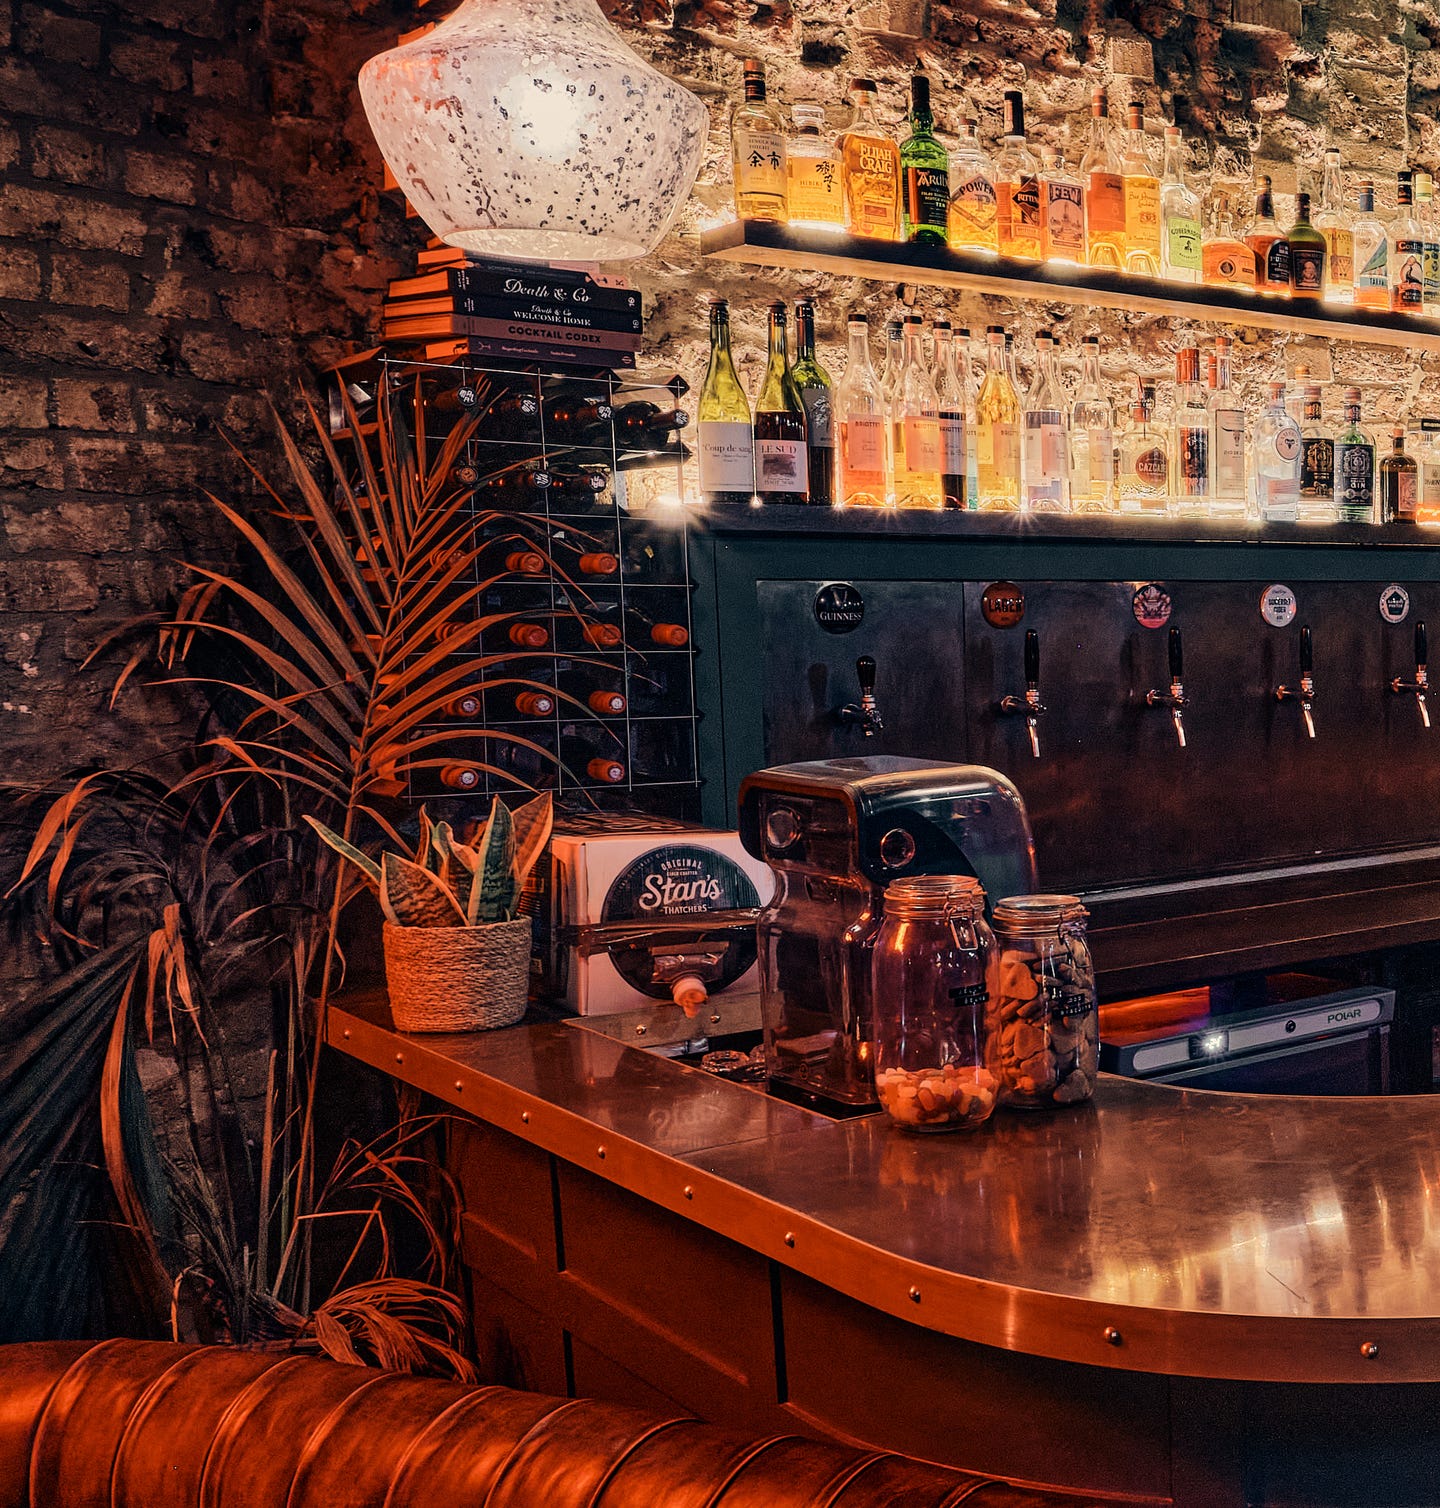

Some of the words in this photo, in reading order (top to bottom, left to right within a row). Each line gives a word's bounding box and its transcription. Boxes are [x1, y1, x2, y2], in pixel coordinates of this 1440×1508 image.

[860, 143, 892, 161] ELIJAH
[860, 156, 892, 174] CRAIG
[1052, 184, 1080, 203] FEW
[503, 278, 550, 298] Death
[553, 288, 568, 302] &
[572, 287, 592, 303] Co
[513, 310, 562, 324] WELCOME
[563, 316, 592, 327] HOME
[508, 325, 563, 340] COCKTAIL
[565, 332, 602, 344] CODEX
[761, 445, 773, 453] LE
[775, 445, 797, 454] SUD
[820, 611, 863, 621] GUINNESS
[661, 858, 702, 871] ORIGINAL
[639, 874, 725, 911] Stan's
[663, 903, 708, 915] THATCHERS
[1327, 1008, 1362, 1024] POLAR
